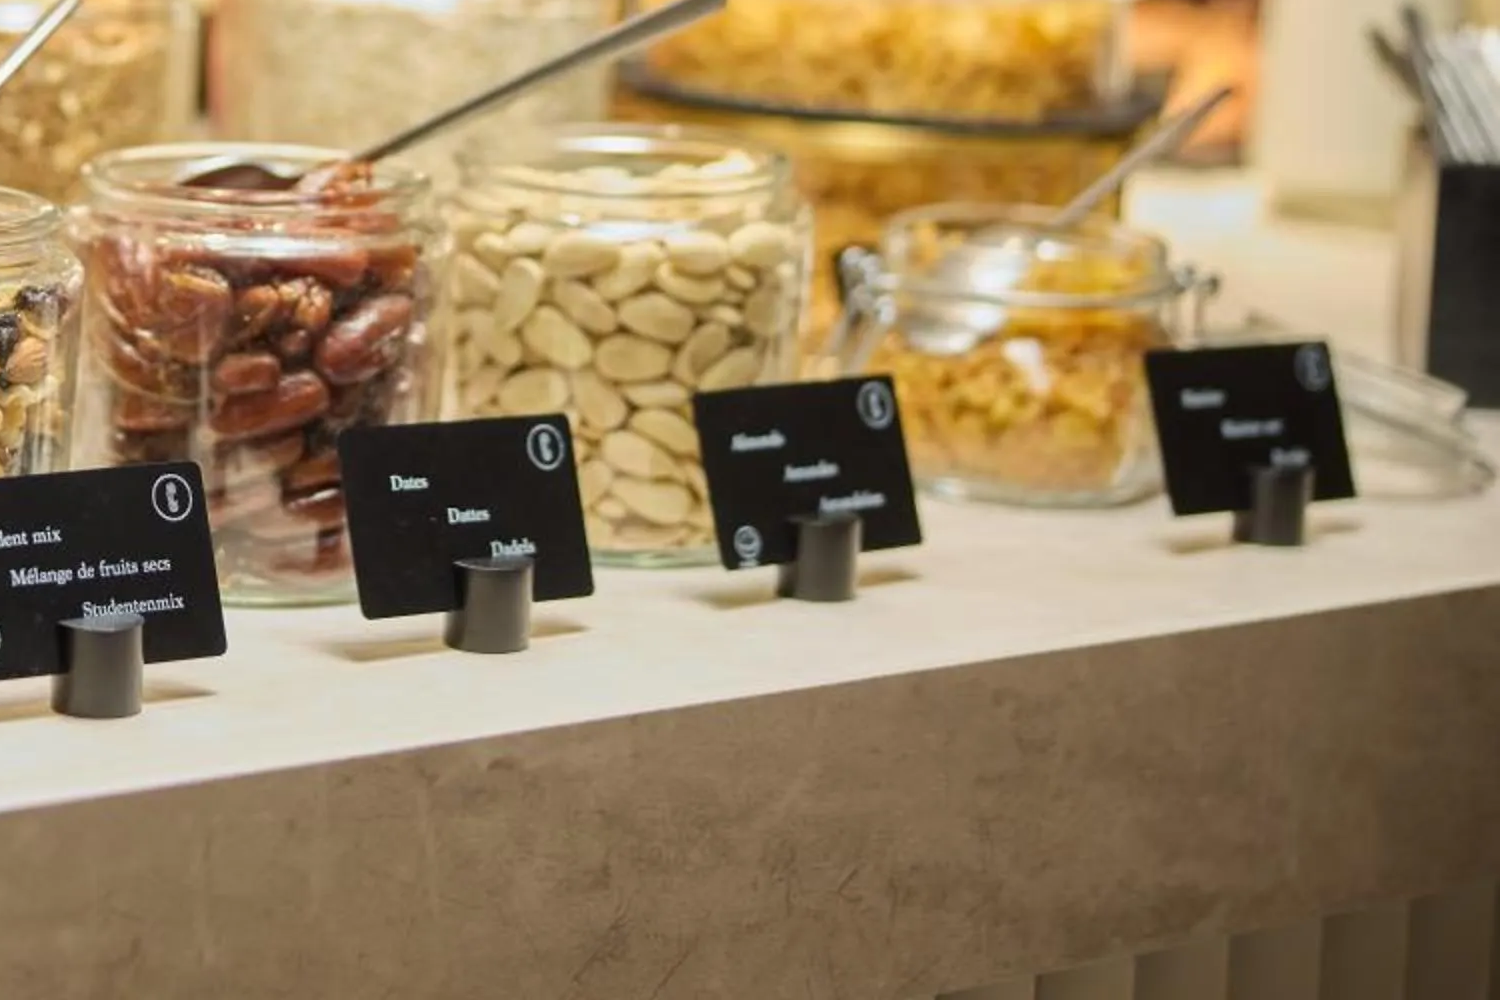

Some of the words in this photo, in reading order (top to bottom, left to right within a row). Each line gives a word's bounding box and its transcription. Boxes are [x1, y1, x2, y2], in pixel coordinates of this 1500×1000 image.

[390, 475, 429, 492] Dates
[33, 526, 62, 544] mix
[9, 564, 73, 587] Mélange
[77, 561, 94, 580] de
[100, 558, 138, 577] fruits
[143, 557, 171, 573] secs
[82, 592, 185, 618] Studentenmix
